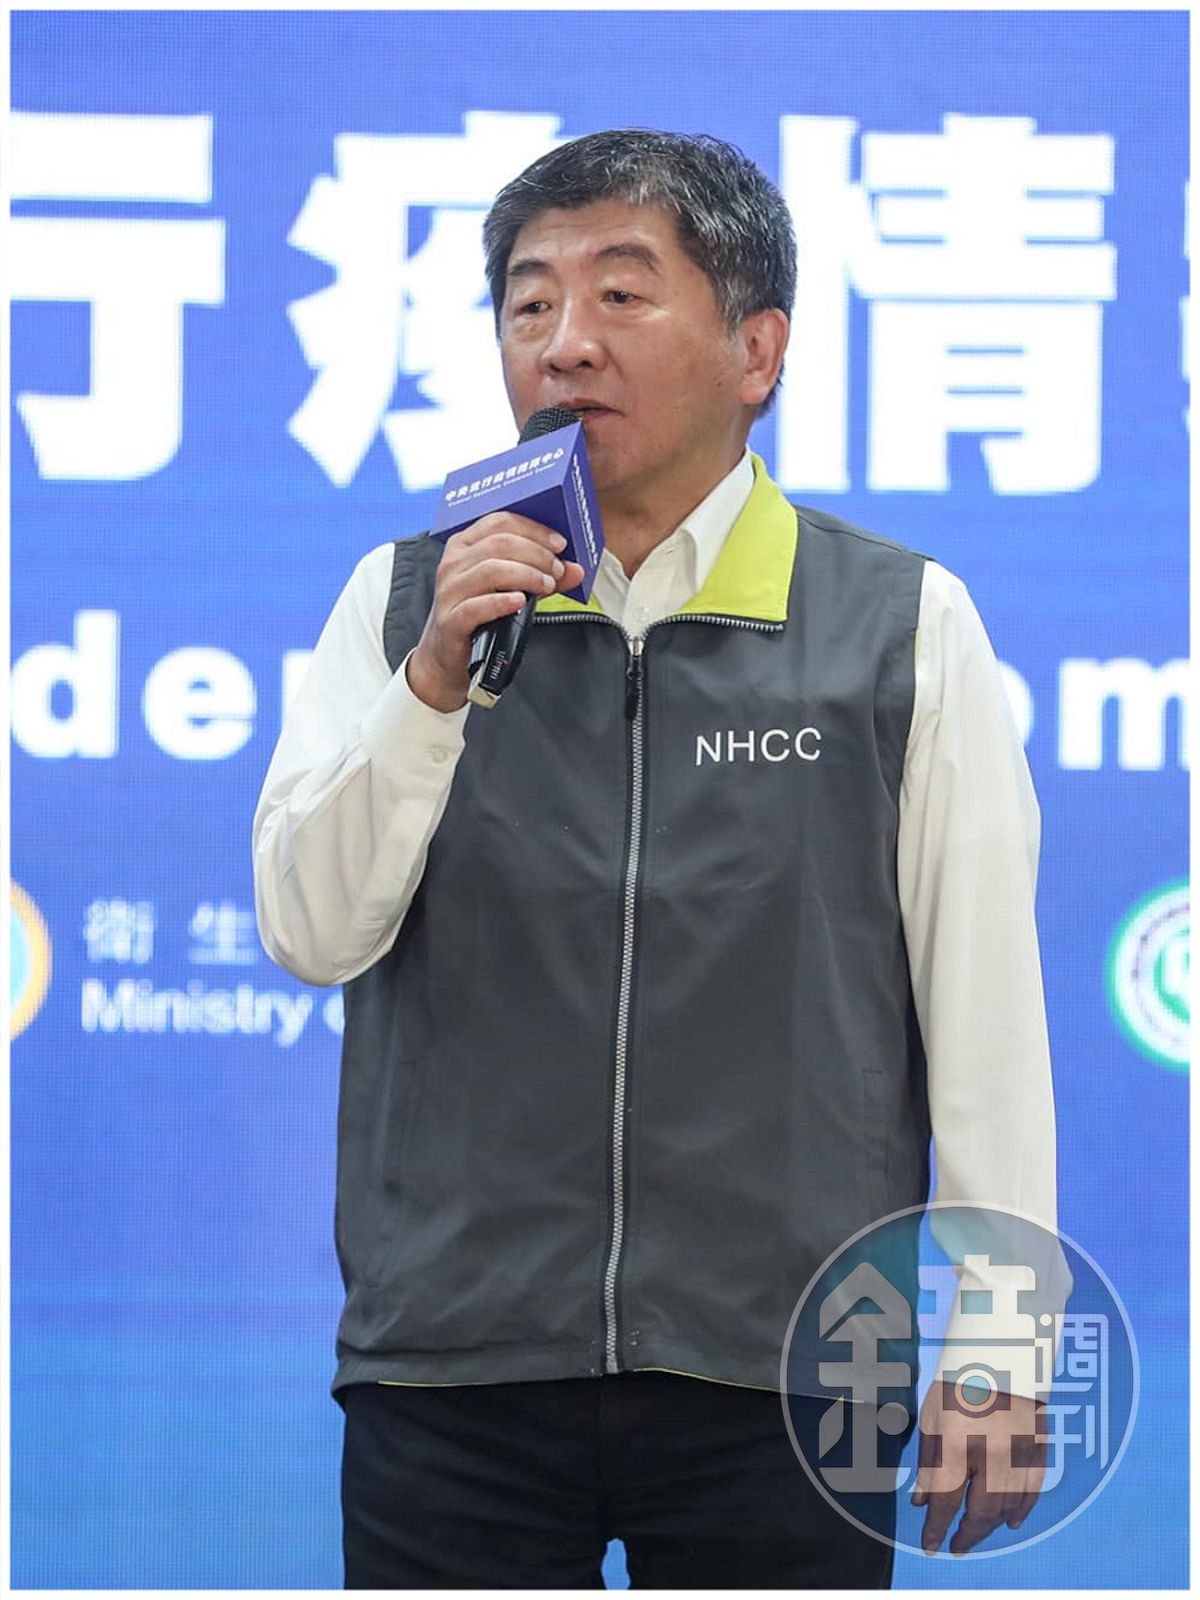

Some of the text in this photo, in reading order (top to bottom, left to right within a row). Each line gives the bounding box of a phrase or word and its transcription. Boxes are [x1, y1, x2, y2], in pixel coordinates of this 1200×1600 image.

[10, 609, 309, 760] de
[696, 727, 822, 766] NHCC
[81, 978, 313, 1047] Ministry
